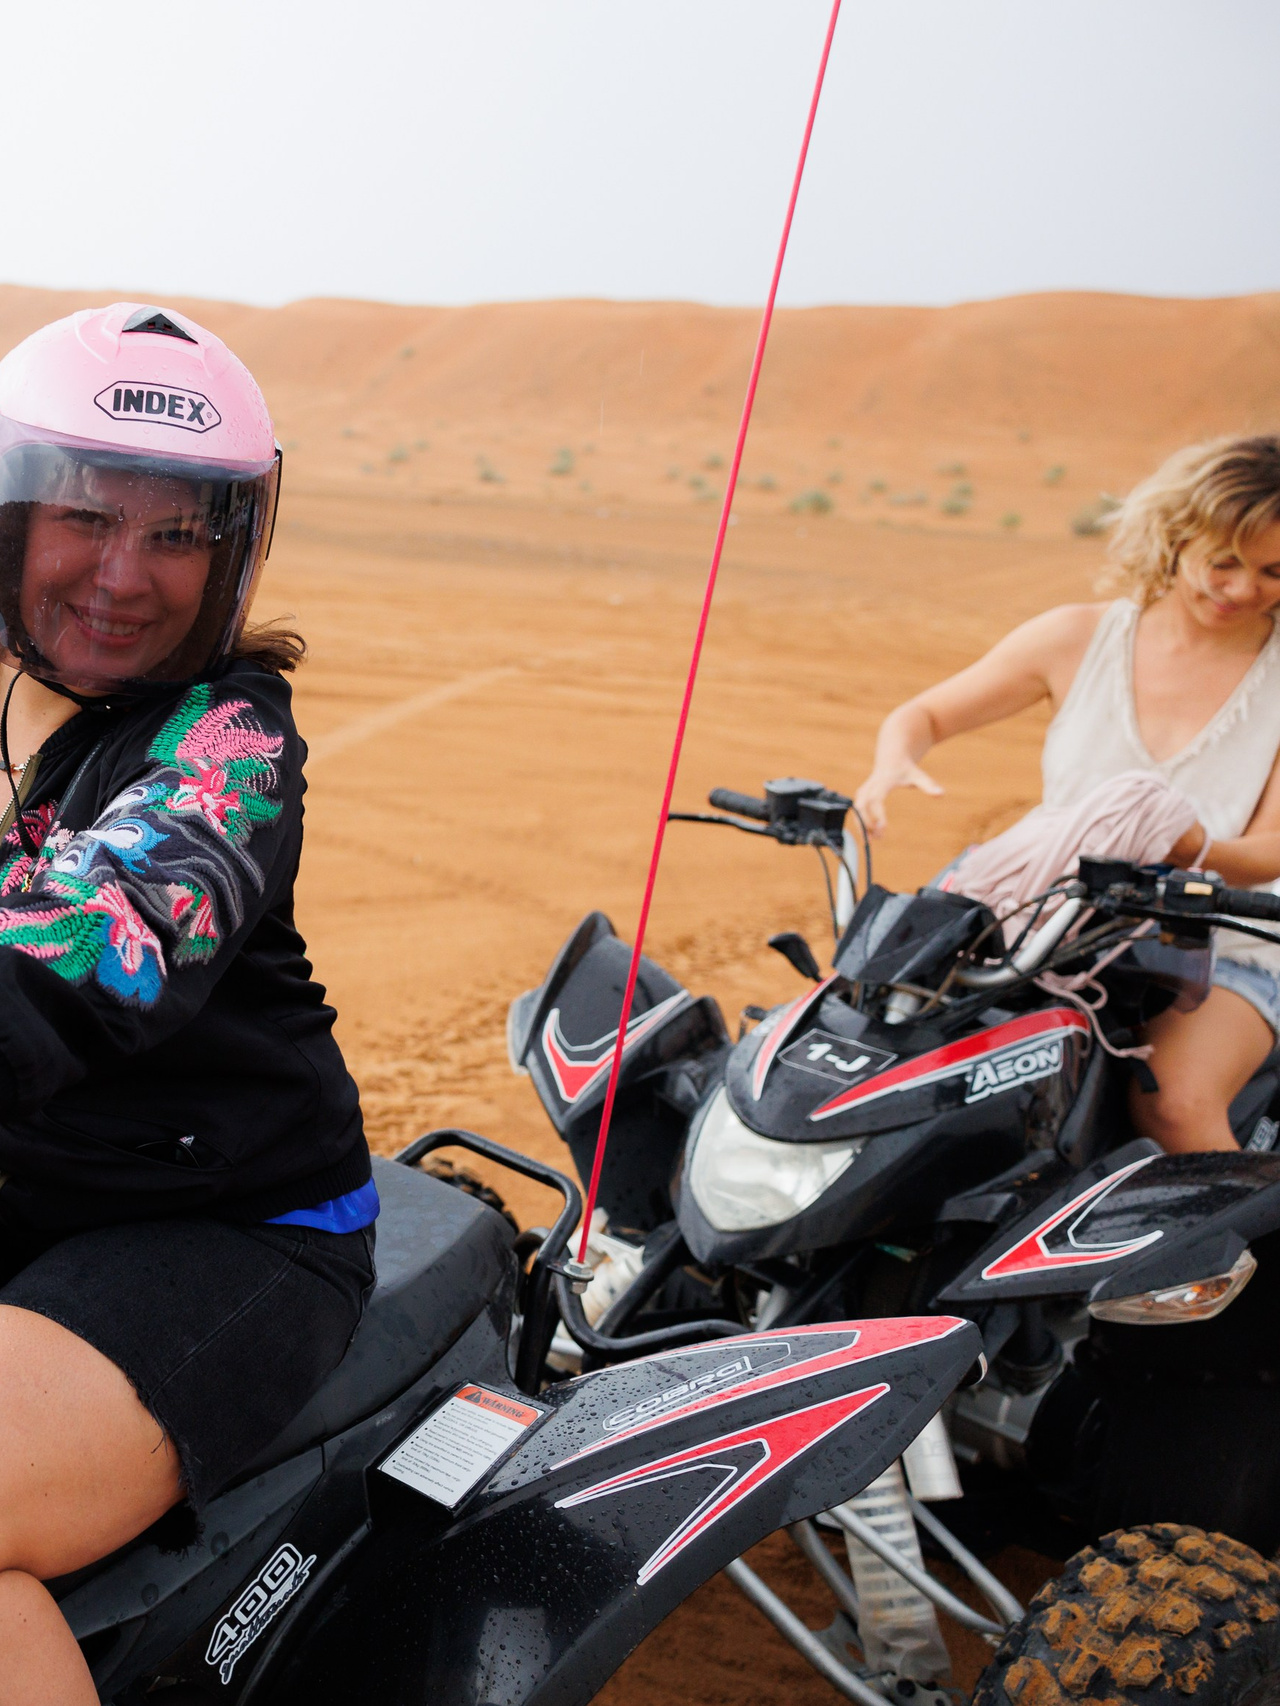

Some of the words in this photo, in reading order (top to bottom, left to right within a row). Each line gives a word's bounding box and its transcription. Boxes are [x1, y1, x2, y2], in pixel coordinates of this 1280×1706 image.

[113, 388, 206, 426] INDEX
[806, 1042, 871, 1073] 1-J
[969, 1042, 1062, 1094] AEON
[482, 1397, 525, 1418] WARNING
[608, 1359, 745, 1427] COBRA
[210, 1549, 298, 1659] 400
